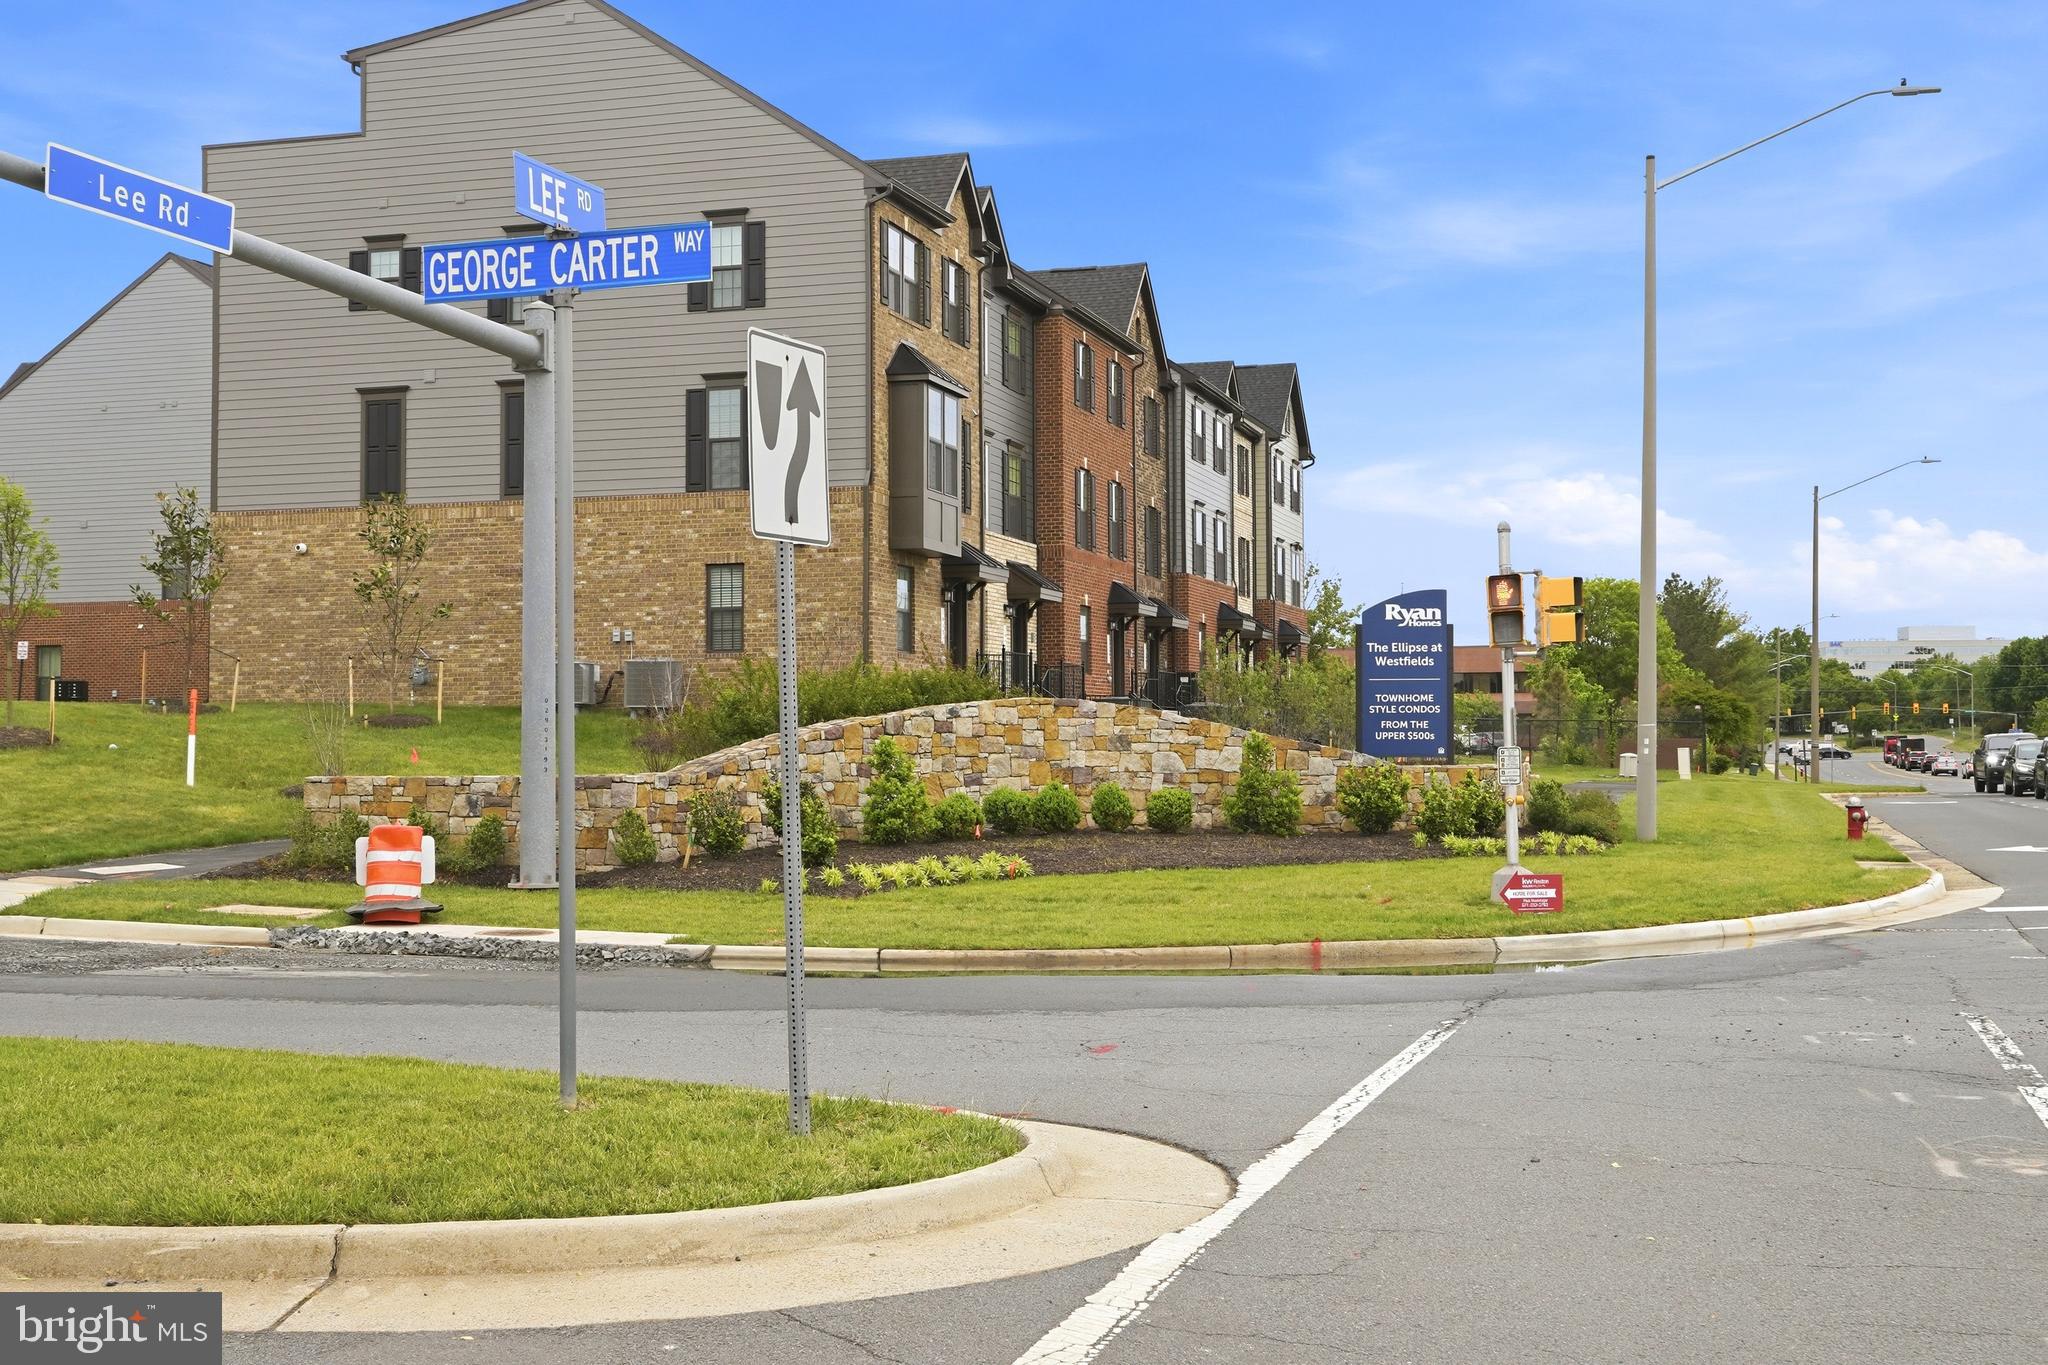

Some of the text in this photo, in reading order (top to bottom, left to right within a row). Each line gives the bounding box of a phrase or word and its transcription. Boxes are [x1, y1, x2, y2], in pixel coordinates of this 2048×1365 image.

[99, 173, 189, 228] Lee Rd
[528, 167, 592, 224] LEE RD
[429, 229, 705, 295] GEORGE CARTER WAY
[1385, 604, 1442, 627] Ryan
[1366, 642, 1443, 655] The Ellipse at
[1375, 656, 1435, 667] Westfields
[1375, 694, 1434, 703] TOWNHOME
[1369, 705, 1441, 714] STYLE CONDOS
[1381, 720, 1429, 729] FROM THE
[1375, 731, 1435, 740] UPPER $500s
